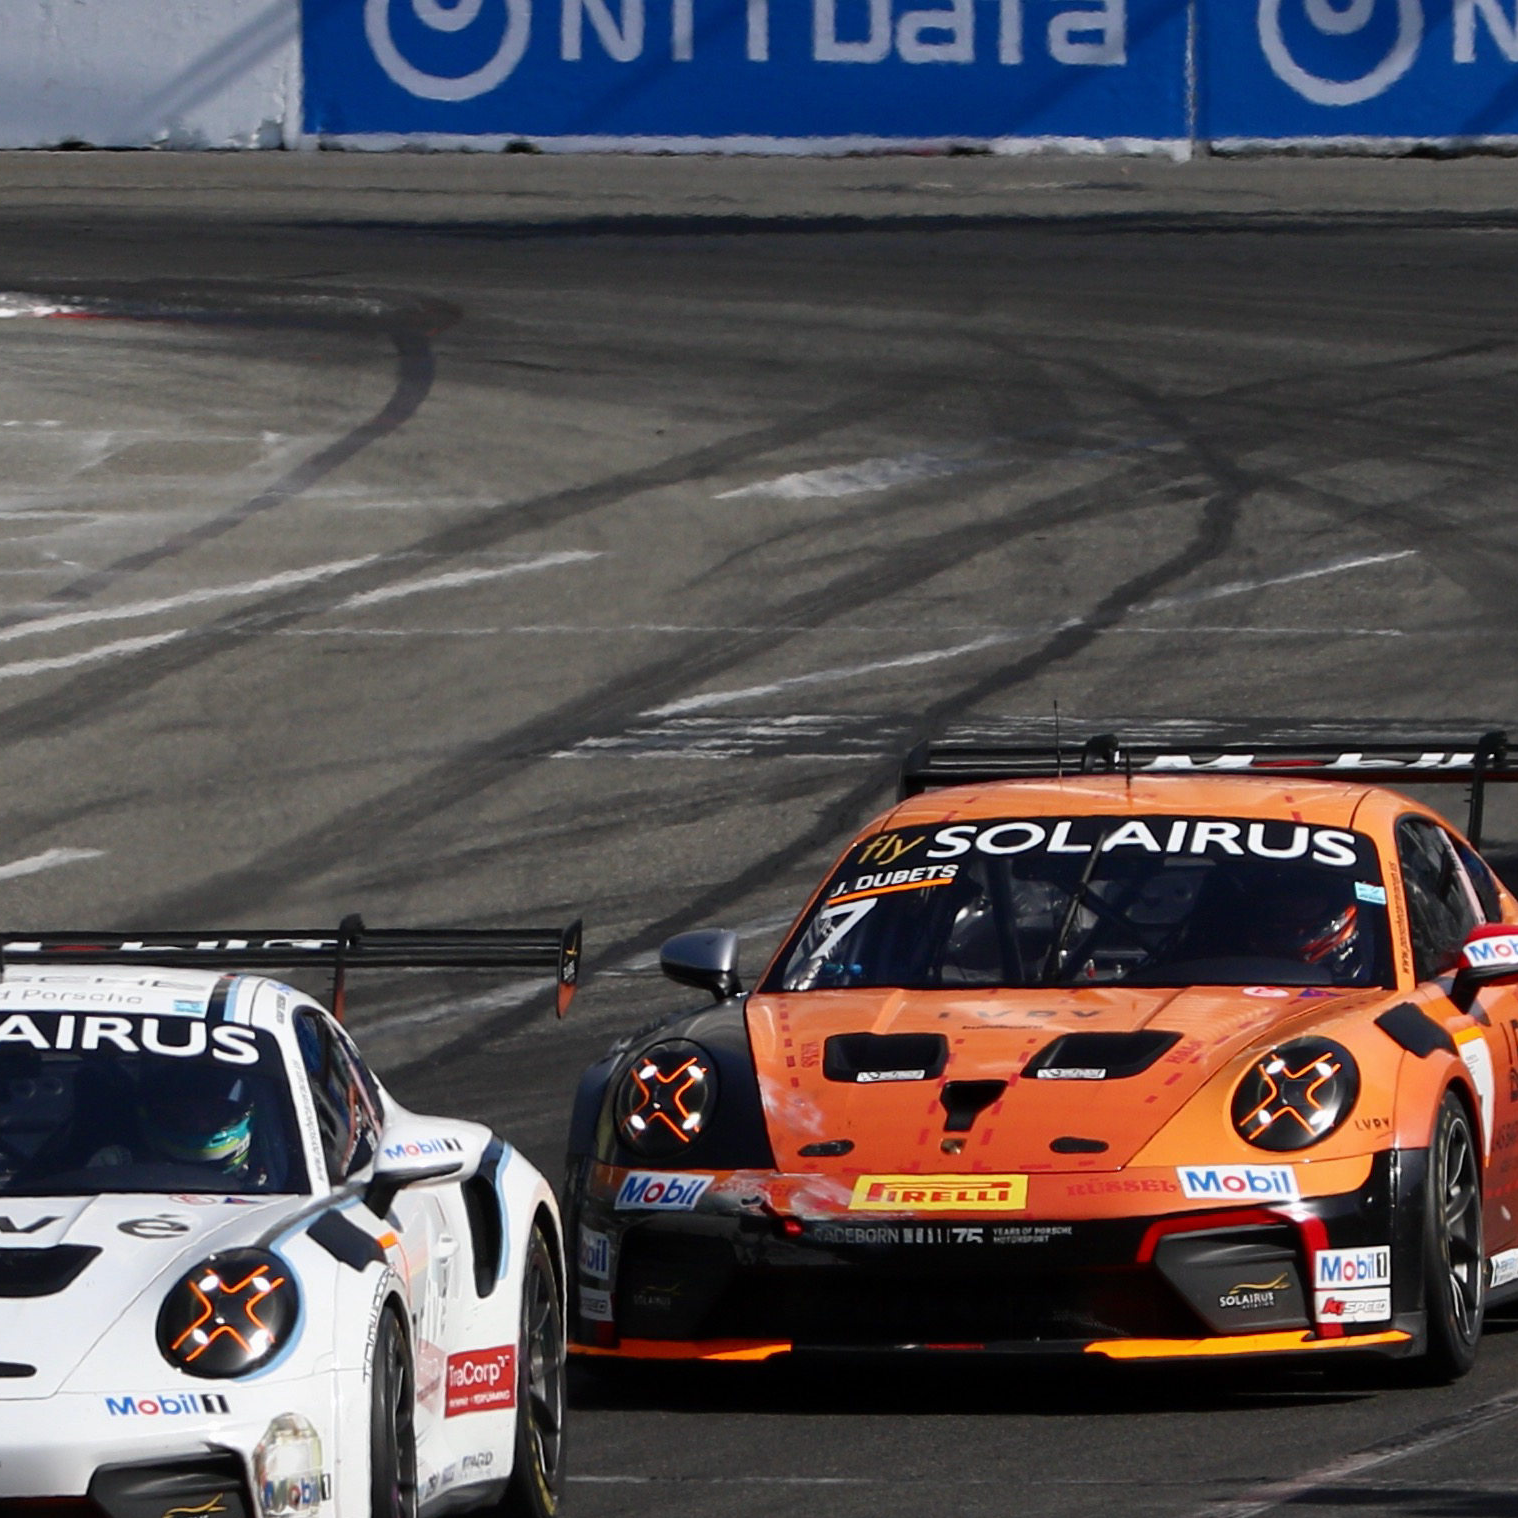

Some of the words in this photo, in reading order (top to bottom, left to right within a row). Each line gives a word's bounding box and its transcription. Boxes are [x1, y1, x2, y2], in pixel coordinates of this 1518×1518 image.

[858, 834, 926, 865] fly
[926, 820, 1358, 867] SOLAIRUS
[831, 881, 848, 897] J.
[855, 864, 959, 890] DUBETS
[22, 988, 143, 1005] Porsche
[384, 1139, 443, 1160] Mobil
[619, 1177, 706, 1206] Mobil
[864, 1182, 1013, 1203] PIRELLI
[1187, 1170, 1292, 1194] Mobil
[815, 1227, 899, 1244] RACEBORN
[952, 1227, 984, 1244] 75
[1320, 1254, 1375, 1281] Mobil
[1219, 1291, 1274, 1308] SOLAIRUS
[106, 1394, 199, 1415] Mobil
